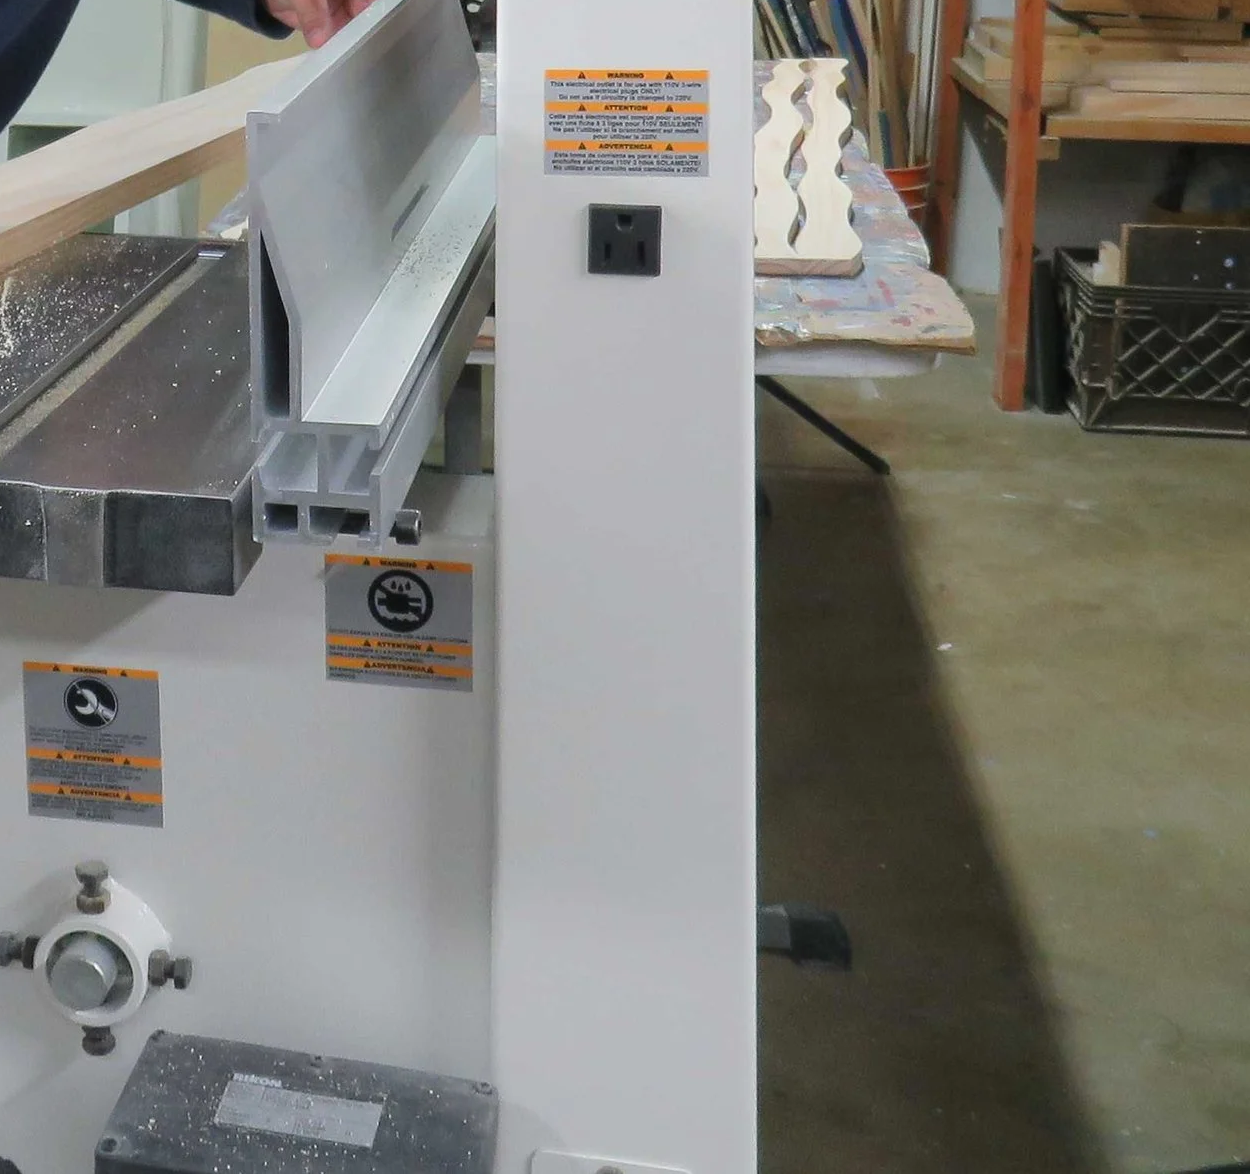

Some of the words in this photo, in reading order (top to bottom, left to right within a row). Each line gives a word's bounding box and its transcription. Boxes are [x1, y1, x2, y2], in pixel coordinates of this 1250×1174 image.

[601, 94, 628, 102] circuitry
[380, 560, 418, 568] WARNING
[377, 641, 422, 650] ATTENTION
[73, 754, 115, 763] ATTENTION
[70, 789, 121, 798] ADVERTENCIA
[233, 1073, 282, 1088] RIKON
